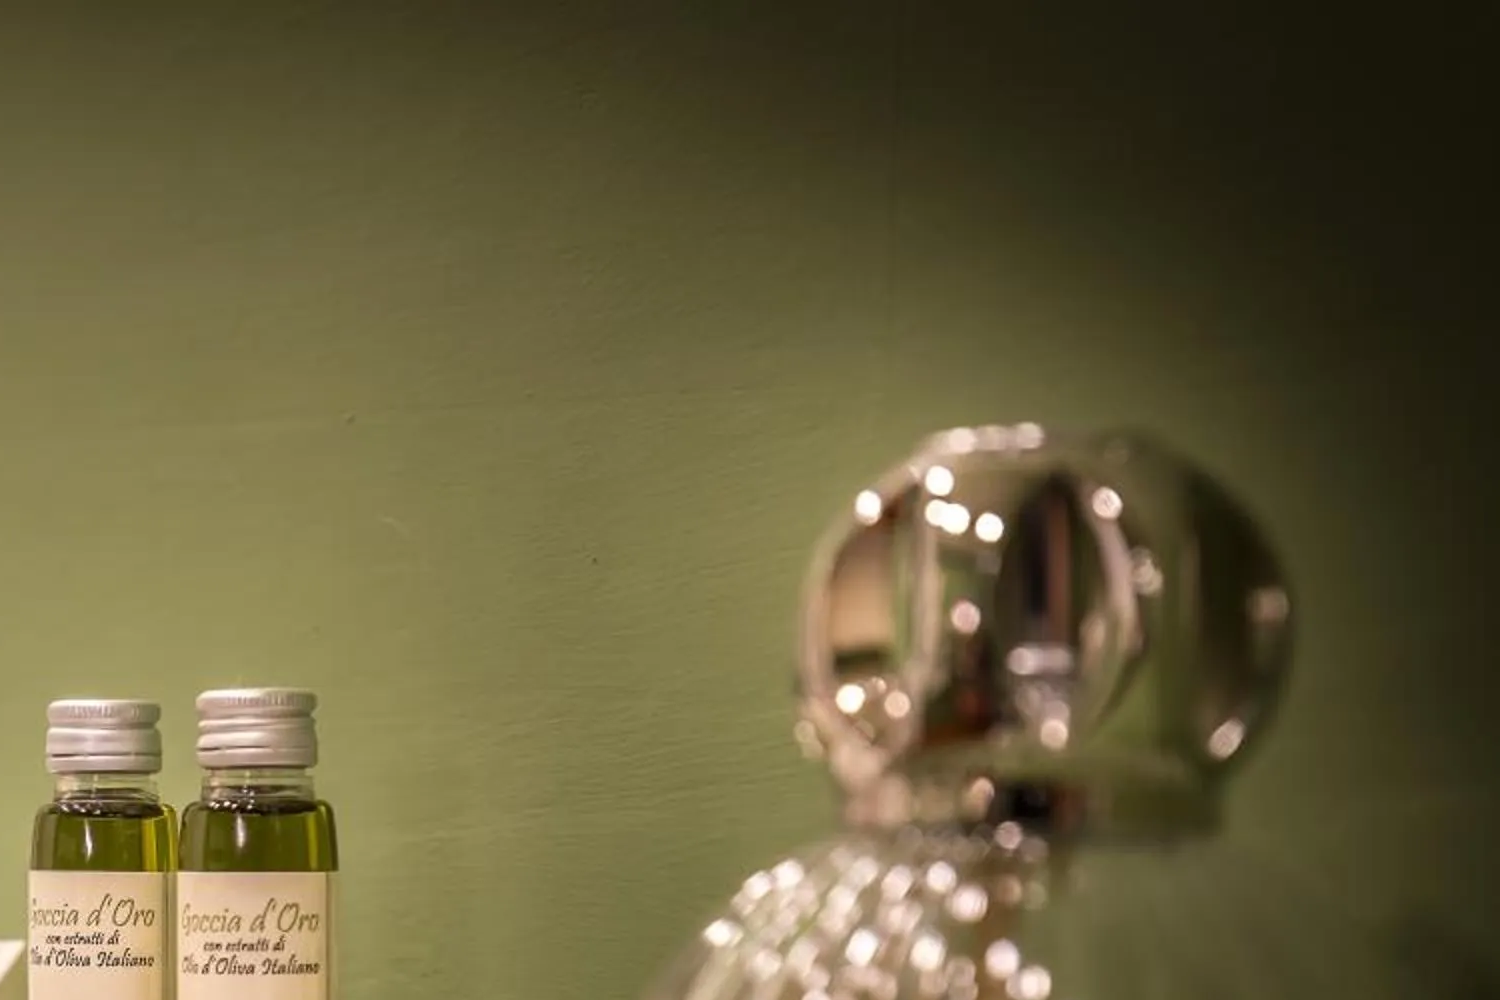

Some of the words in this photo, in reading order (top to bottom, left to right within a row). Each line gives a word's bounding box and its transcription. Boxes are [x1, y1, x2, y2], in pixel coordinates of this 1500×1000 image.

[86, 893, 155, 927] d'Oro
[182, 902, 242, 936] Goccia
[249, 897, 320, 933] d'Oro
[45, 934, 61, 945] con
[64, 931, 105, 945] estratti
[107, 929, 121, 945] di
[203, 941, 223, 951] con
[225, 938, 269, 951] estratti
[273, 934, 287, 951] di
[44, 947, 91, 967] d'Oliva
[96, 947, 156, 967] Italiano
[201, 954, 255, 975] d'Oliva
[261, 953, 321, 975] Italiano
